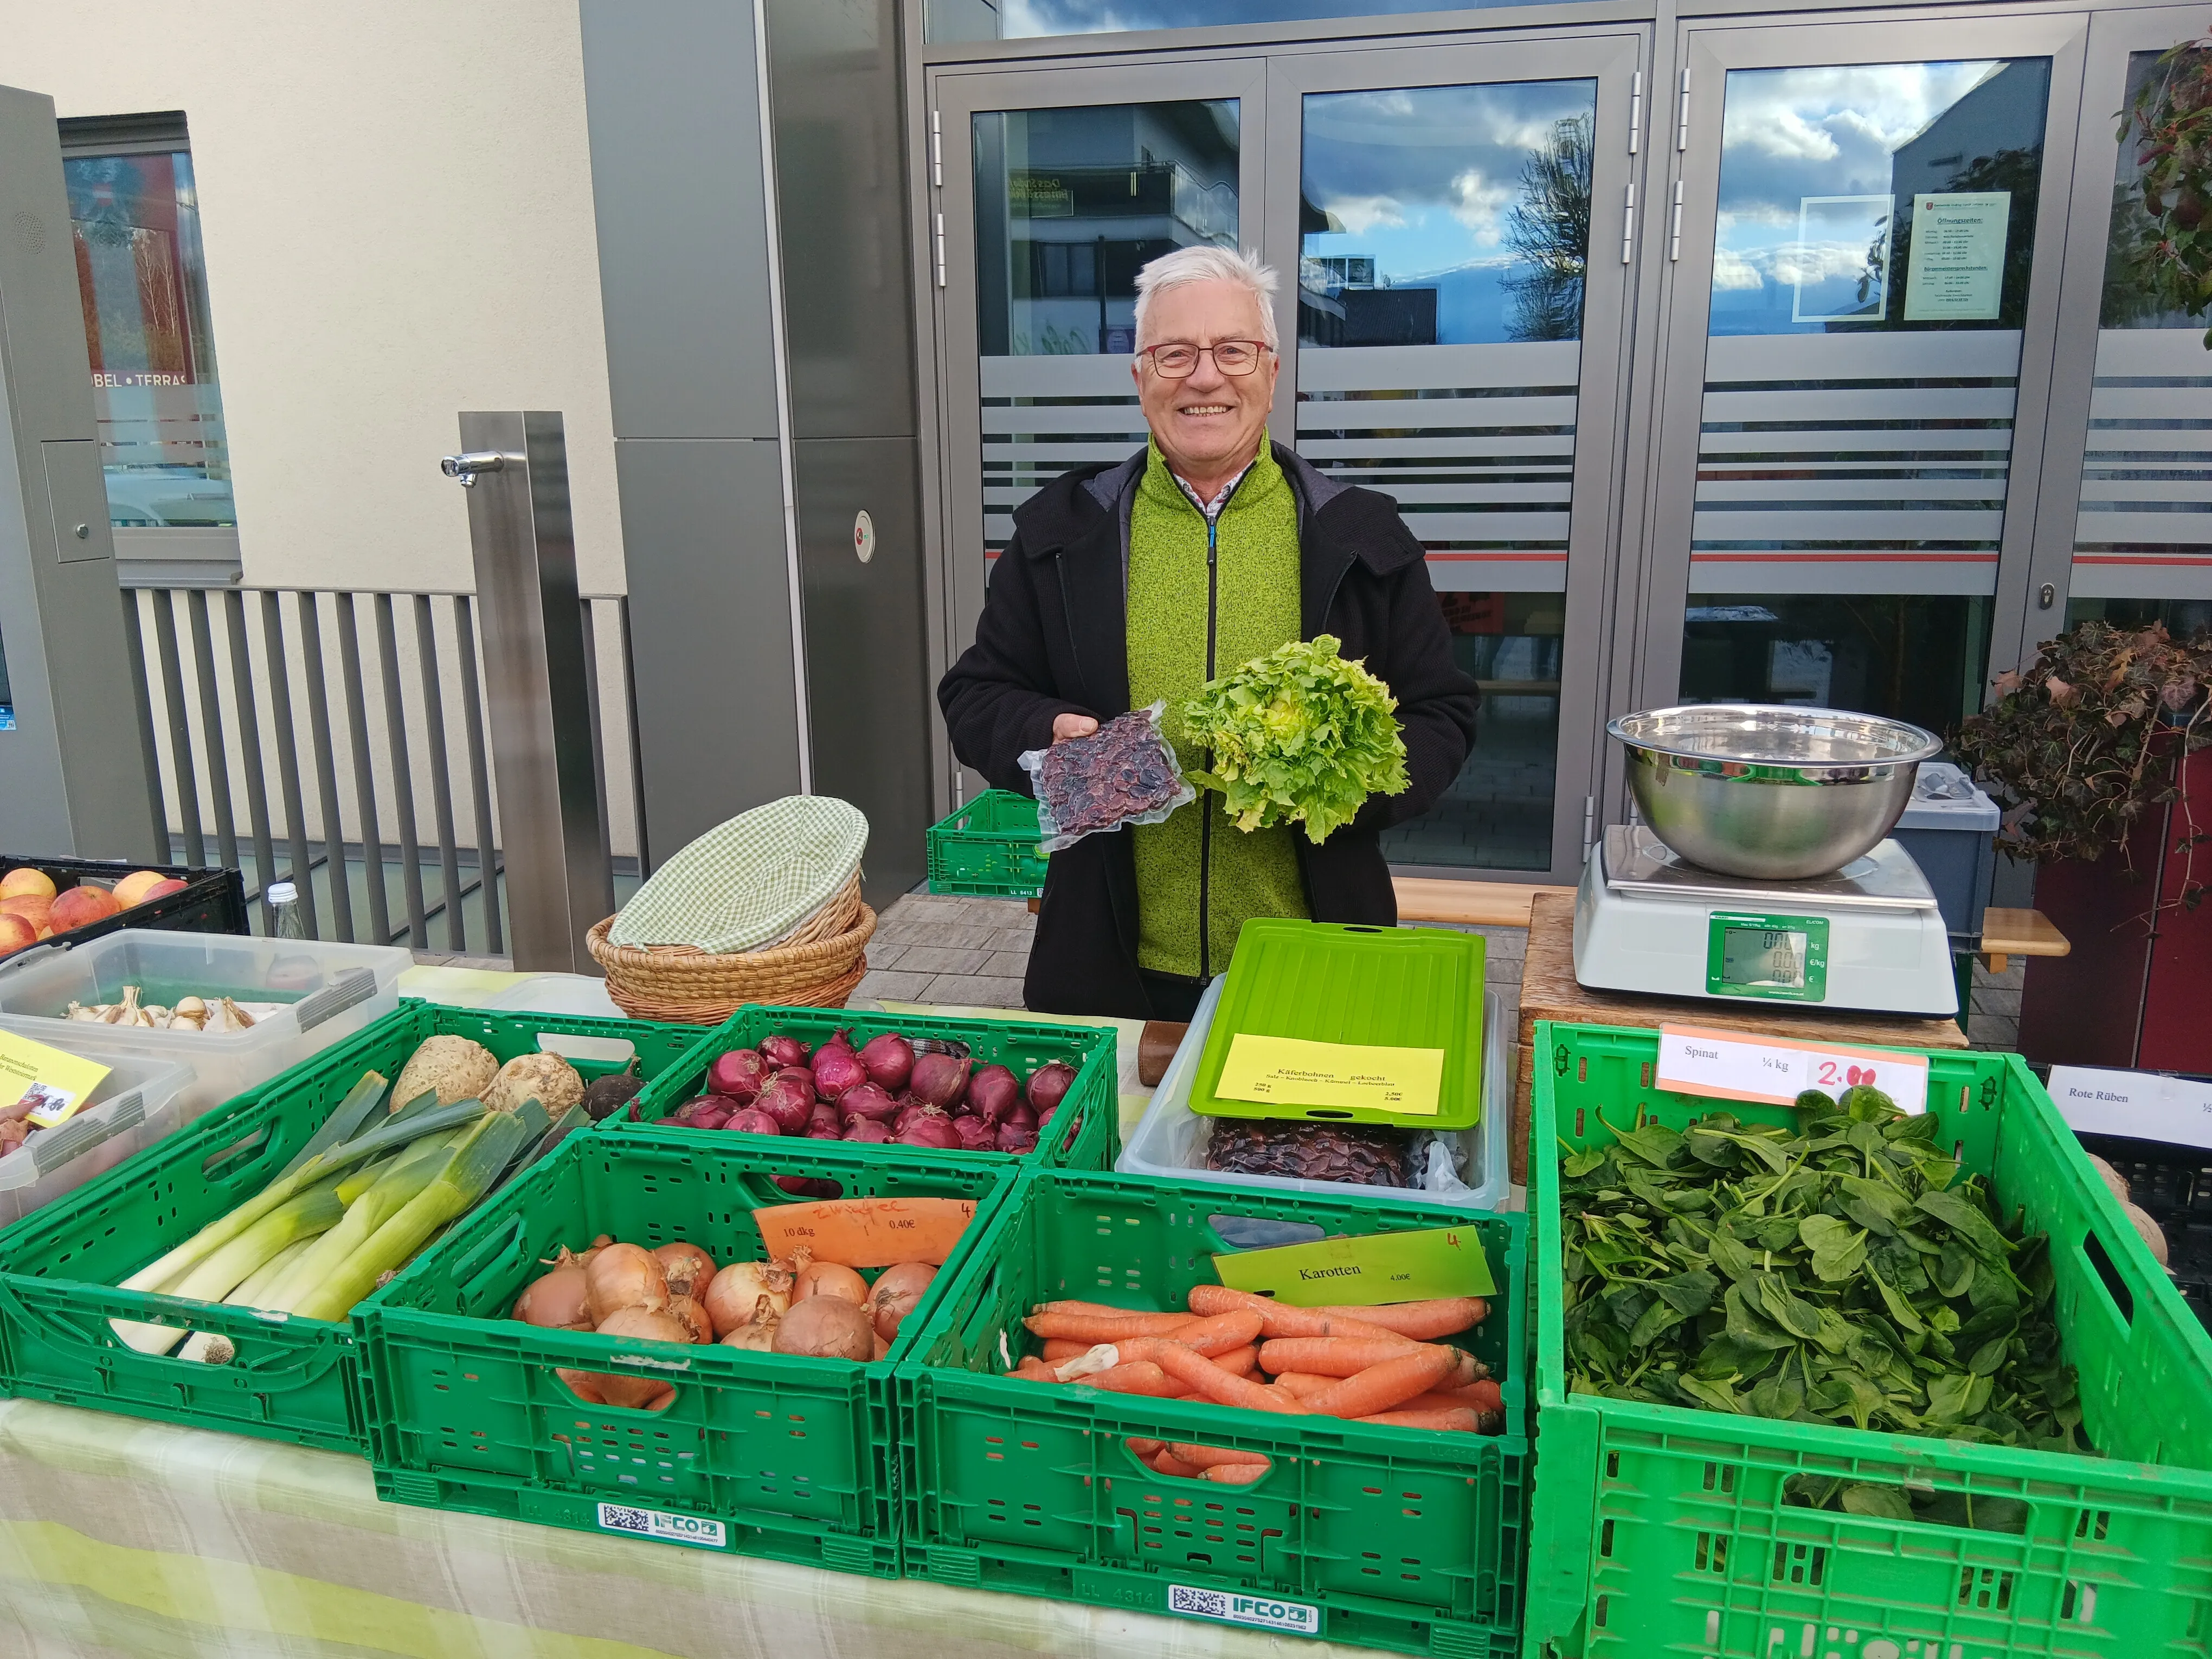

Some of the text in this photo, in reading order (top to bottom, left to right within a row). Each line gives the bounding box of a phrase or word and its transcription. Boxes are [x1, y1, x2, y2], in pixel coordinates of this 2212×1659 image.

[1809, 959, 1825, 968] €/kg
[1685, 1045, 1719, 1059] Spinat
[1775, 1059, 1789, 1072] kg
[1277, 1068, 1334, 1078] Käferbohnen
[2069, 1088, 2093, 1099] Rote
[2096, 1091, 2129, 1103] Rüben
[961, 1203, 971, 1219] 4
[783, 1226, 815, 1238] 10 dkg
[889, 1219, 916, 1229] 0.40€
[1447, 1232, 1462, 1251] 4
[1298, 1265, 1411, 1282] Karotten 4.00€
[654, 1513, 699, 1533] IFCO
[1233, 1597, 1286, 1619] IFCO
